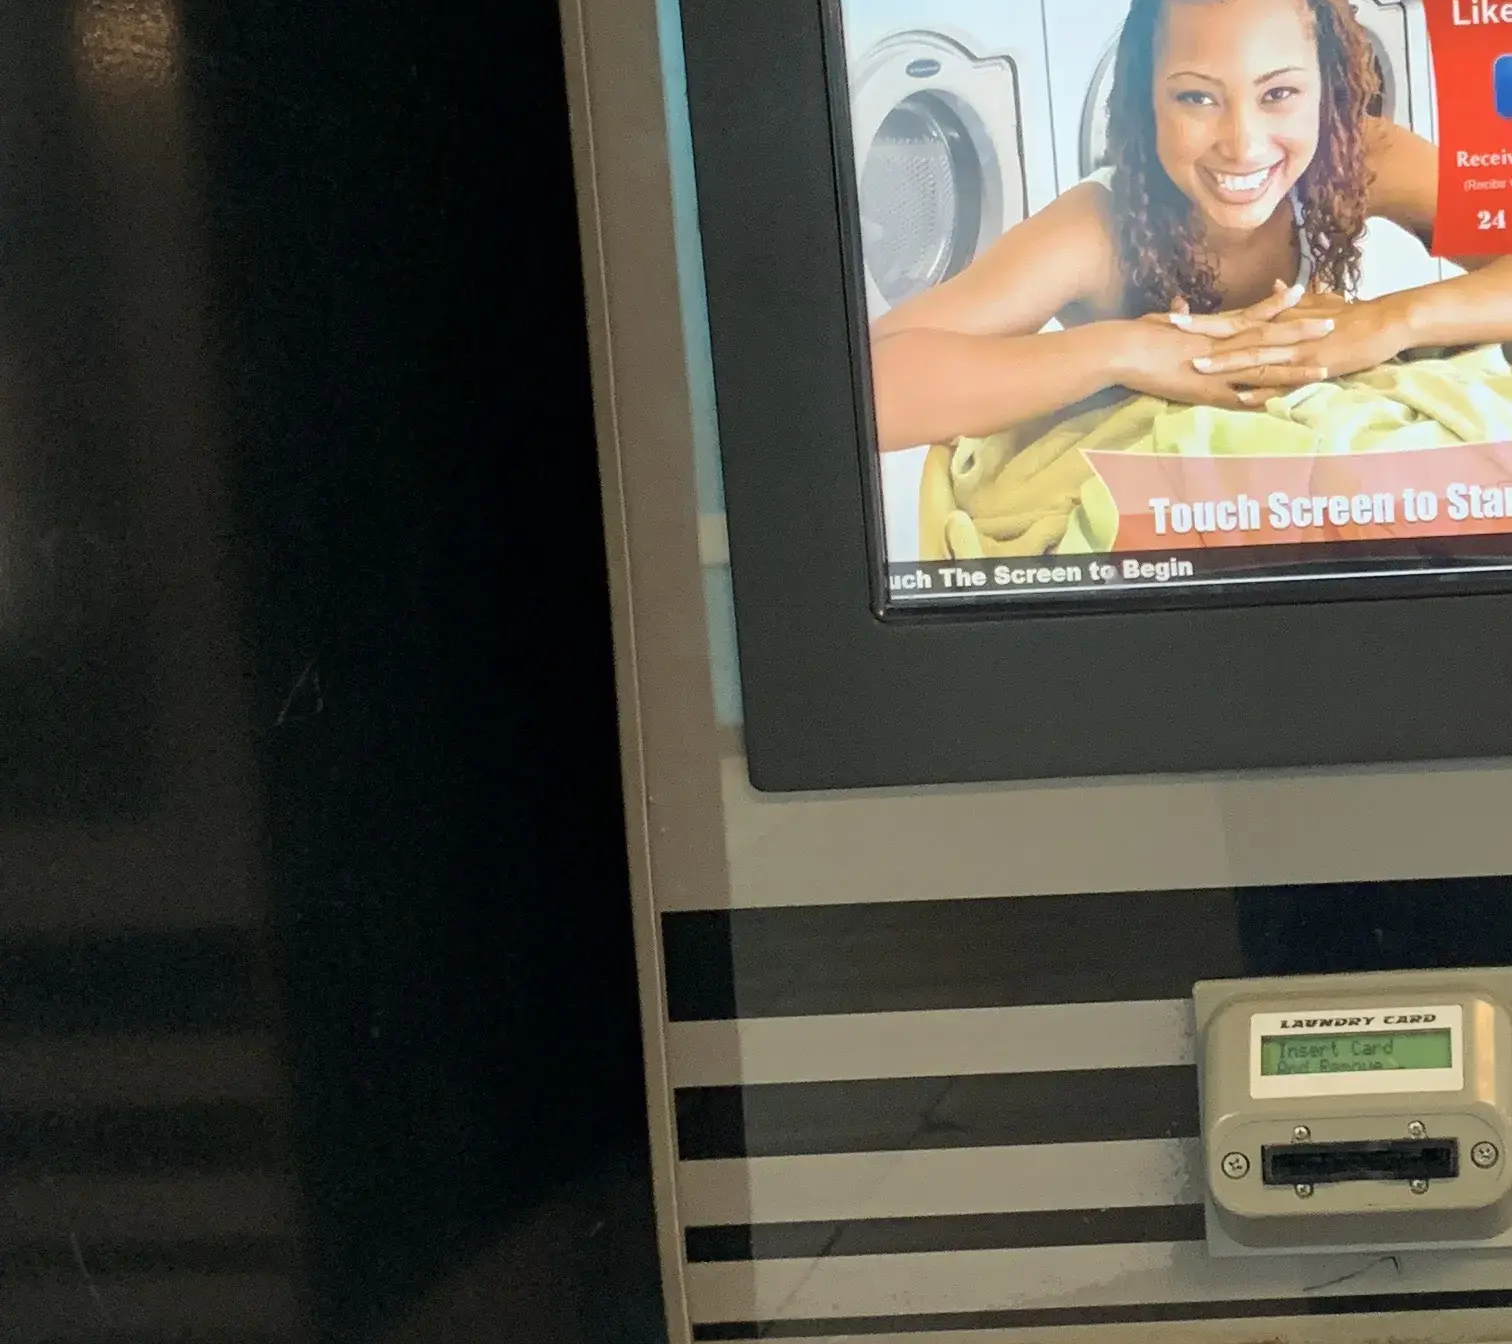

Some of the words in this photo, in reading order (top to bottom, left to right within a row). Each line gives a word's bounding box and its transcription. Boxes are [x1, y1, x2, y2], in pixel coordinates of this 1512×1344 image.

[1477, 209, 1506, 230] 24
[1147, 493, 1261, 534] Touch
[1267, 491, 1395, 529] Screen
[1401, 488, 1438, 522] to
[937, 566, 987, 588] The
[993, 564, 1082, 585] Screen
[1087, 560, 1117, 585] to
[1121, 556, 1194, 582] Begin
[1279, 1016, 1375, 1029] LAUNDRY
[1382, 1013, 1437, 1025] CARD
[1279, 1041, 1340, 1059] Insert
[1351, 1038, 1395, 1056] Card
